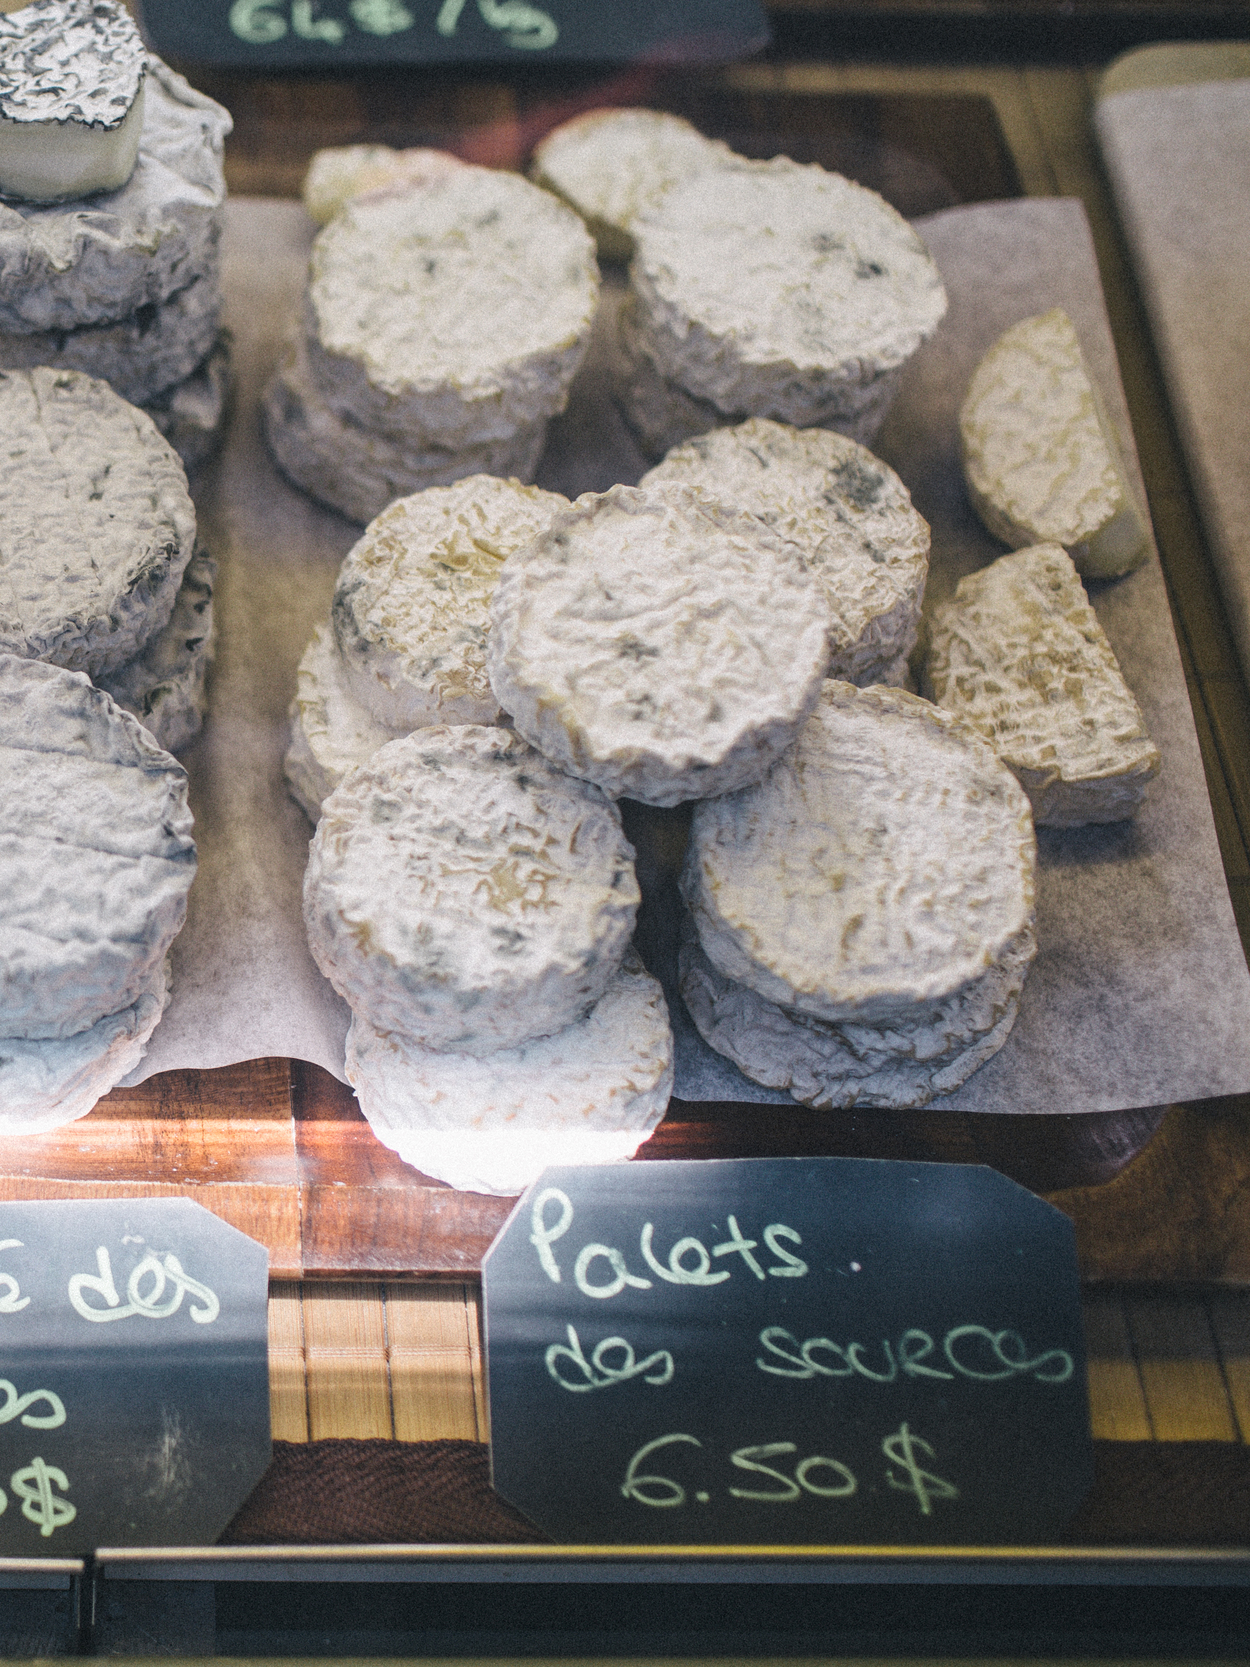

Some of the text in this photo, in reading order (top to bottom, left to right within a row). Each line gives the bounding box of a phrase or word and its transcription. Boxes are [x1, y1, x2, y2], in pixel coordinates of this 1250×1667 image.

[545, 1323, 675, 1393] des
[621, 1422, 959, 1515] 6.50 $
